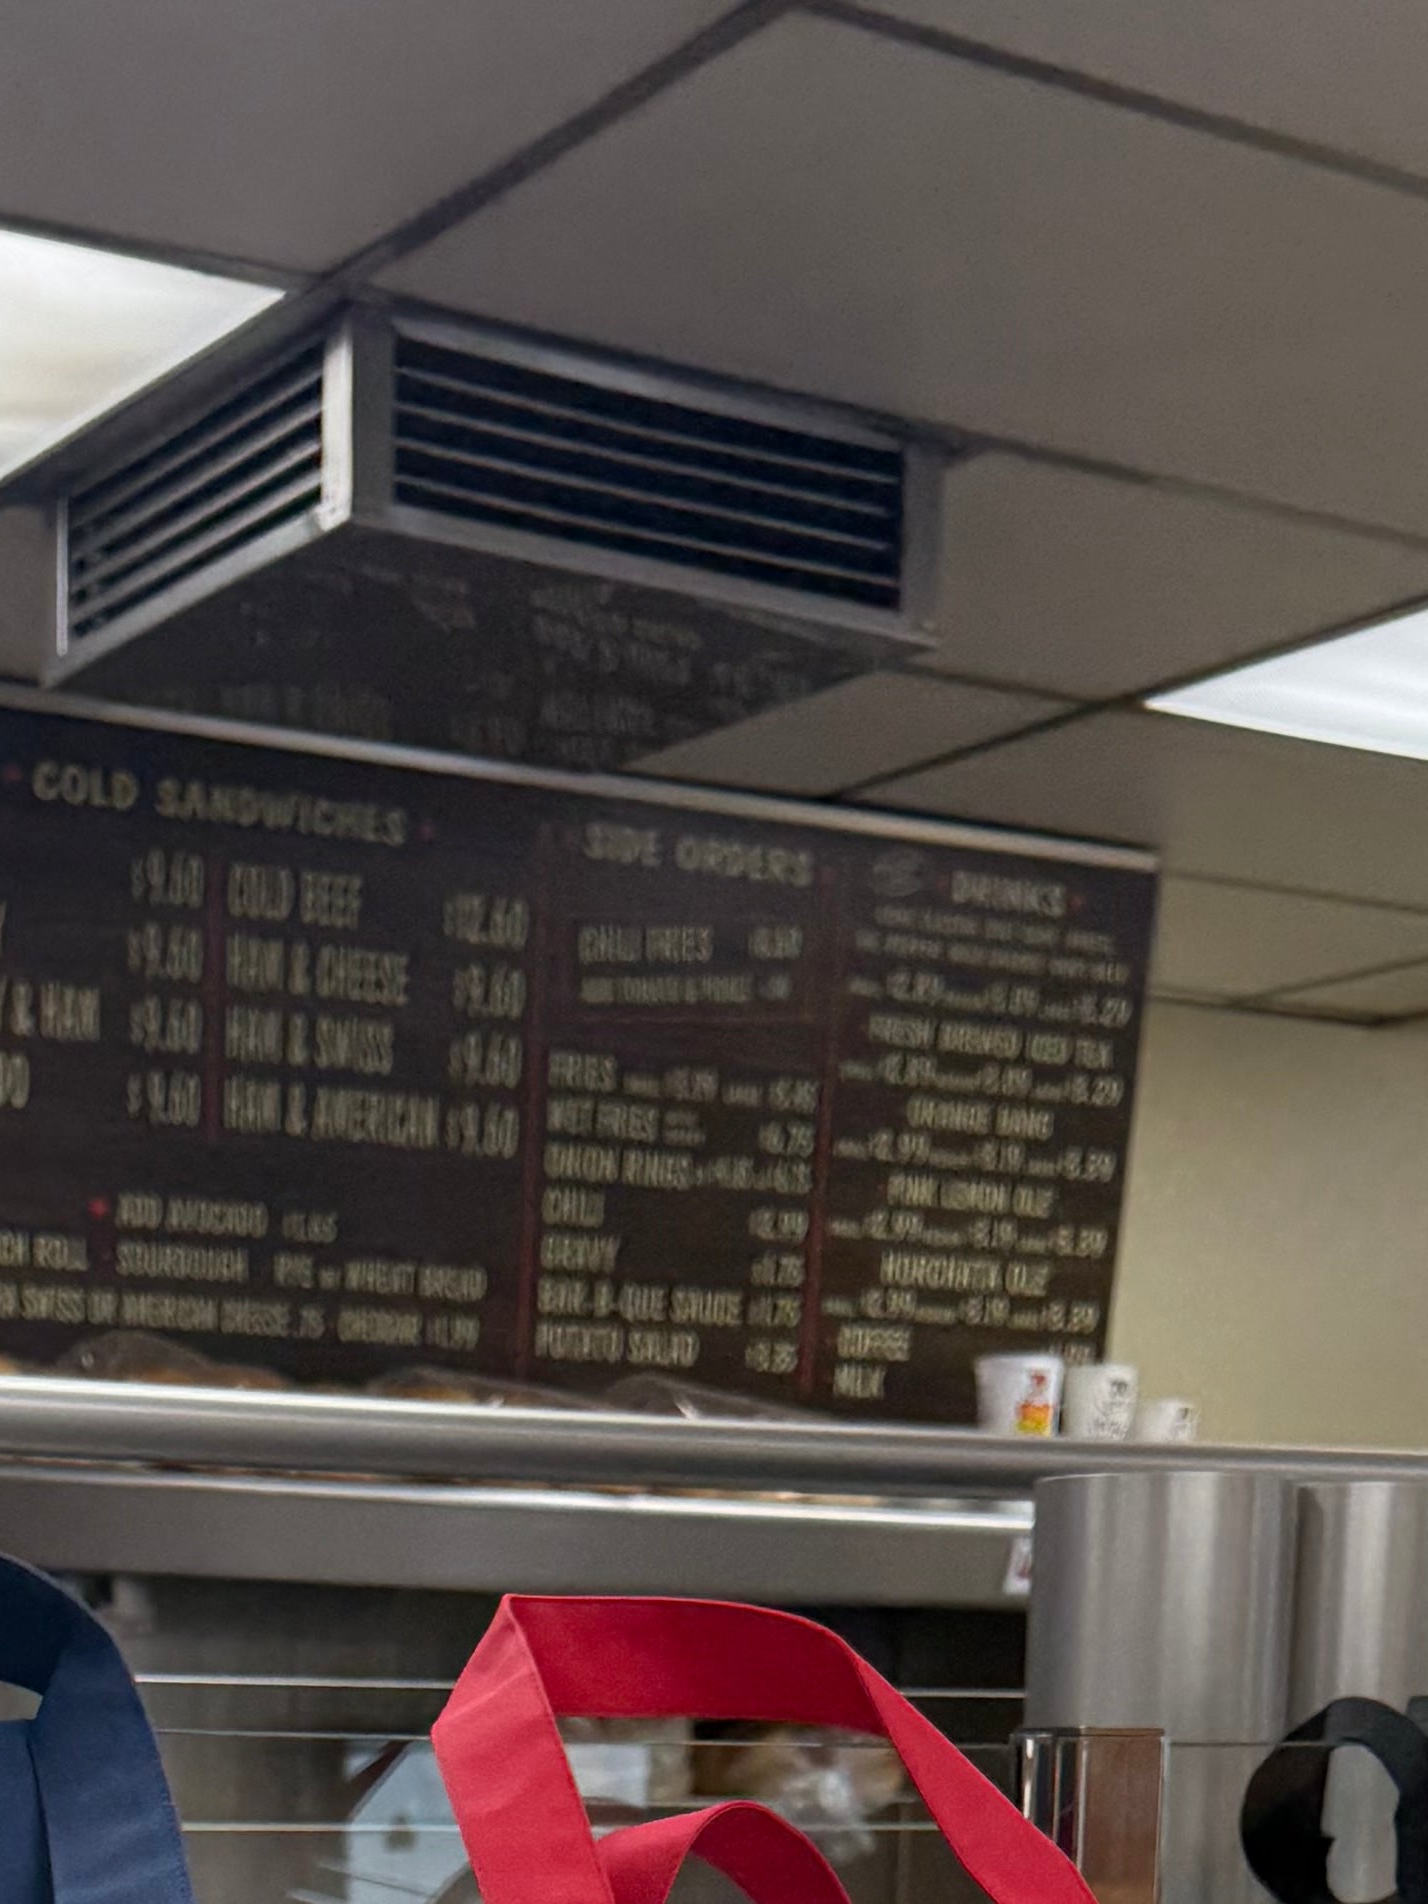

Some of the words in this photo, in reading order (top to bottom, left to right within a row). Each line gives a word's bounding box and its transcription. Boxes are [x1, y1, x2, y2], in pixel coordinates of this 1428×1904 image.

[33, 760, 139, 811] COLD
[155, 778, 409, 848] SANDWICHES
[584, 822, 662, 867] SIDE
[676, 836, 814, 887] ORDERS
[299, 870, 363, 930] BEEF
[951, 869, 1067, 919] DRINKS
[315, 943, 410, 1007] CHEESE
[40, 980, 101, 1041] HAM
